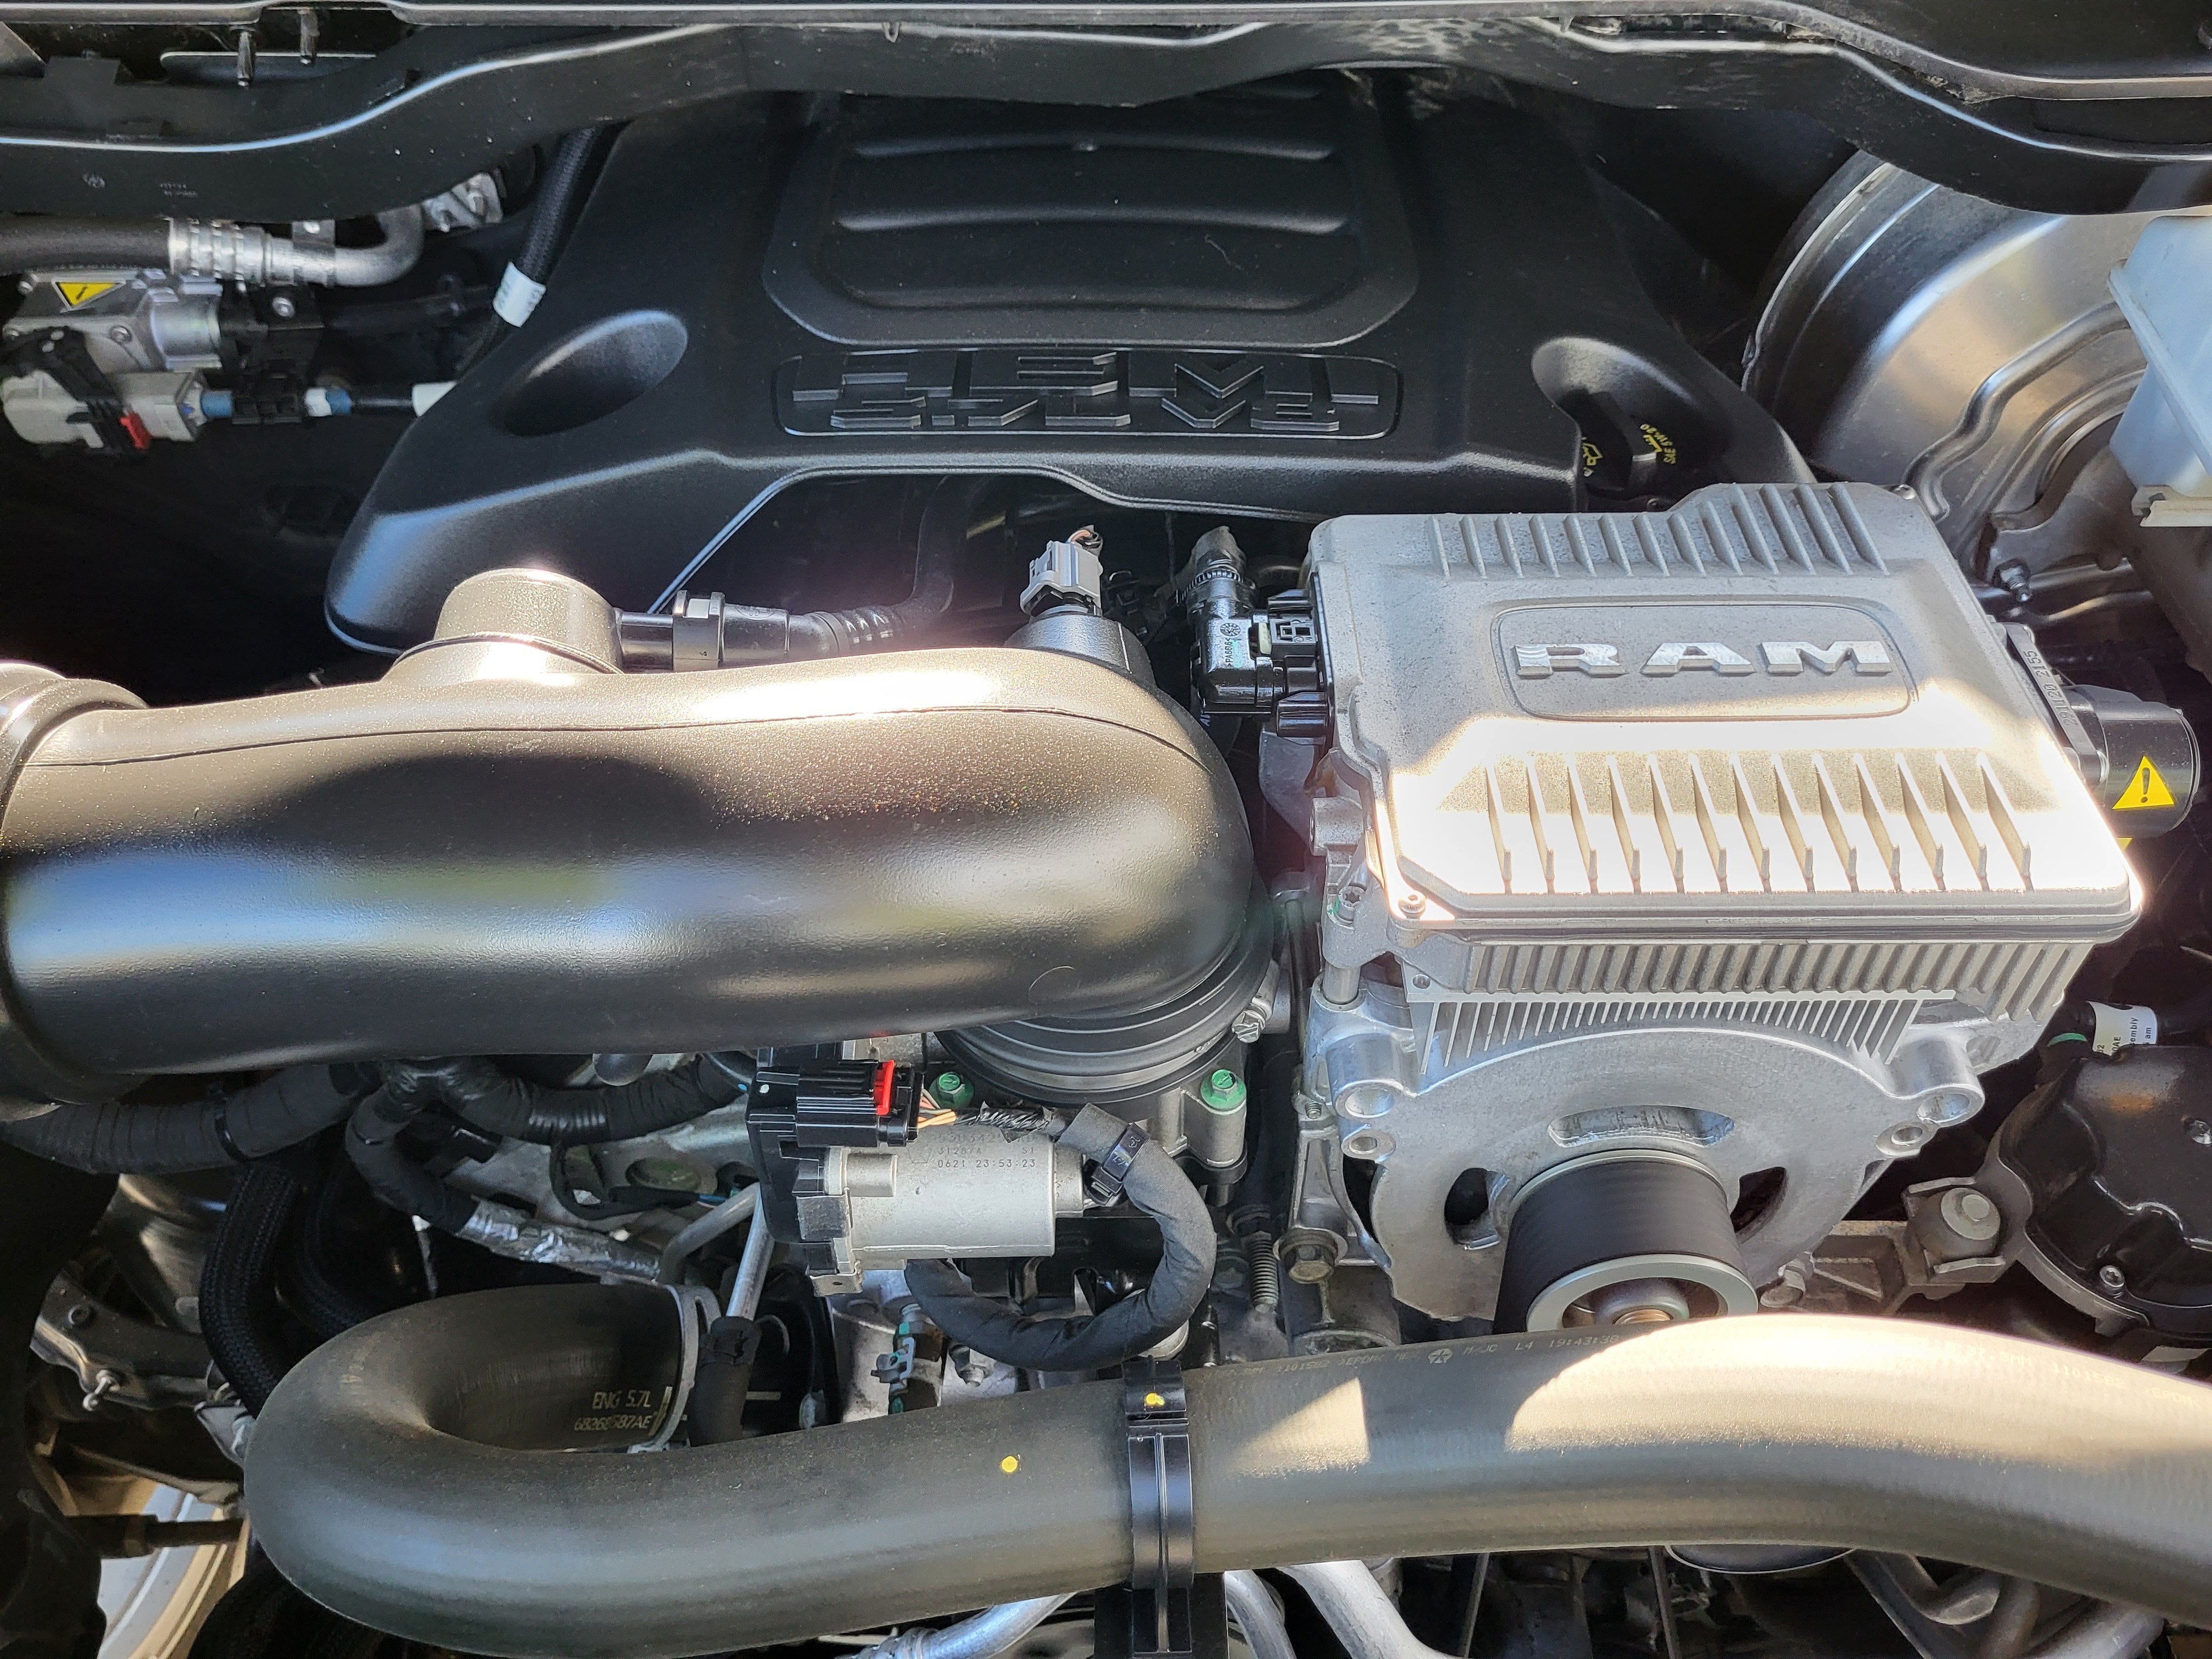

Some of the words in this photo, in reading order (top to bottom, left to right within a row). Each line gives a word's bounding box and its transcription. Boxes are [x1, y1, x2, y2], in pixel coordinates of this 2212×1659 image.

[1514, 640, 1893, 677] RAM
[2129, 1017, 2138, 1044] embly
[937, 1159, 966, 1168] 0621
[975, 1159, 1036, 1168] 23:53:23
[592, 1390, 622, 1410] ENG
